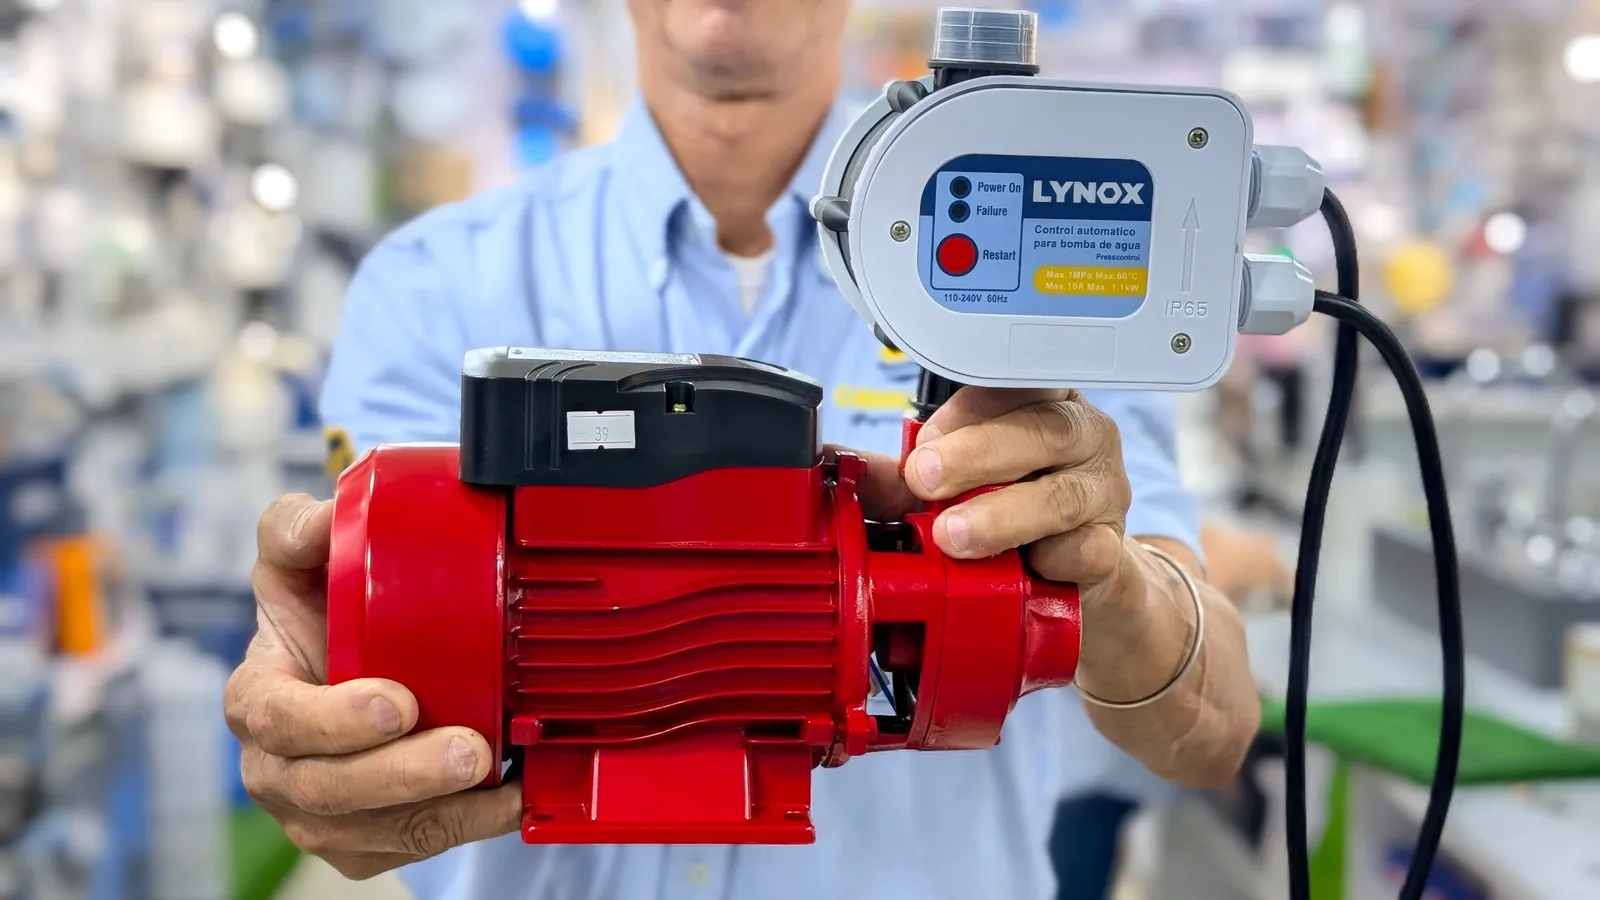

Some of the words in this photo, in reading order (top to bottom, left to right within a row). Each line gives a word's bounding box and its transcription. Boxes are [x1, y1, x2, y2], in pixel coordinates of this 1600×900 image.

[977, 181, 1006, 193] Power
[1008, 182, 1021, 193] On
[1032, 179, 1145, 205] LYNOX
[976, 205, 1008, 217] Failure
[1034, 224, 1074, 235] Control
[1076, 226, 1136, 237] automatico
[1033, 240, 1057, 250] para
[1060, 239, 1096, 249] bomba
[1099, 240, 1112, 250] de
[1114, 242, 1141, 252] agua
[982, 249, 1017, 261] Restart
[1095, 253, 1141, 261] Presscontrol
[944, 293, 983, 303] 110-240V
[986, 294, 1009, 303] 60Hz
[1164, 300, 1208, 317] IP65
[595, 426, 609, 442] 39
